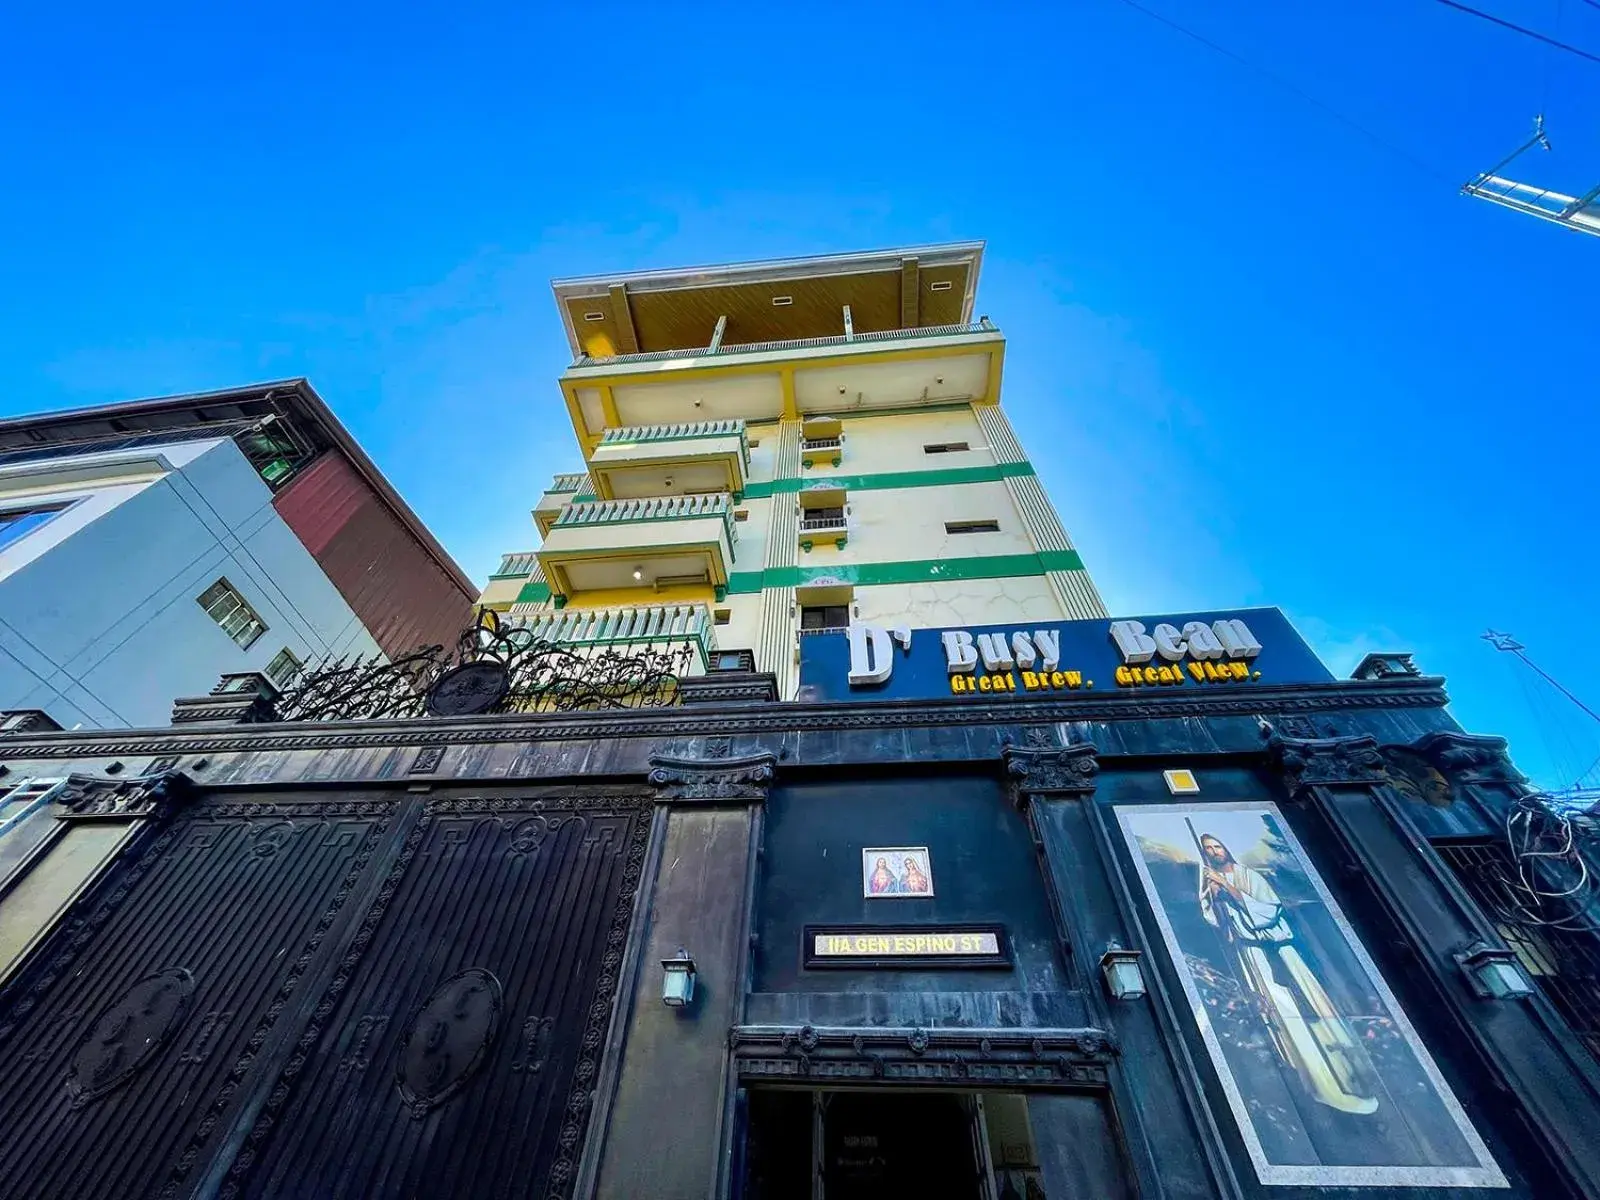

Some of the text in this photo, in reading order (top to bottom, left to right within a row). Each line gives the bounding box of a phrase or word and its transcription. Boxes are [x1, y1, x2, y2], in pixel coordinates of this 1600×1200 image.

[941, 629, 1061, 673] Busy
[1109, 618, 1263, 664] Bean
[951, 671, 1016, 694] Great
[1115, 663, 1185, 687] Great
[856, 937, 890, 953] GEN
[894, 936, 956, 953] ESPINO
[961, 934, 983, 951] ST
